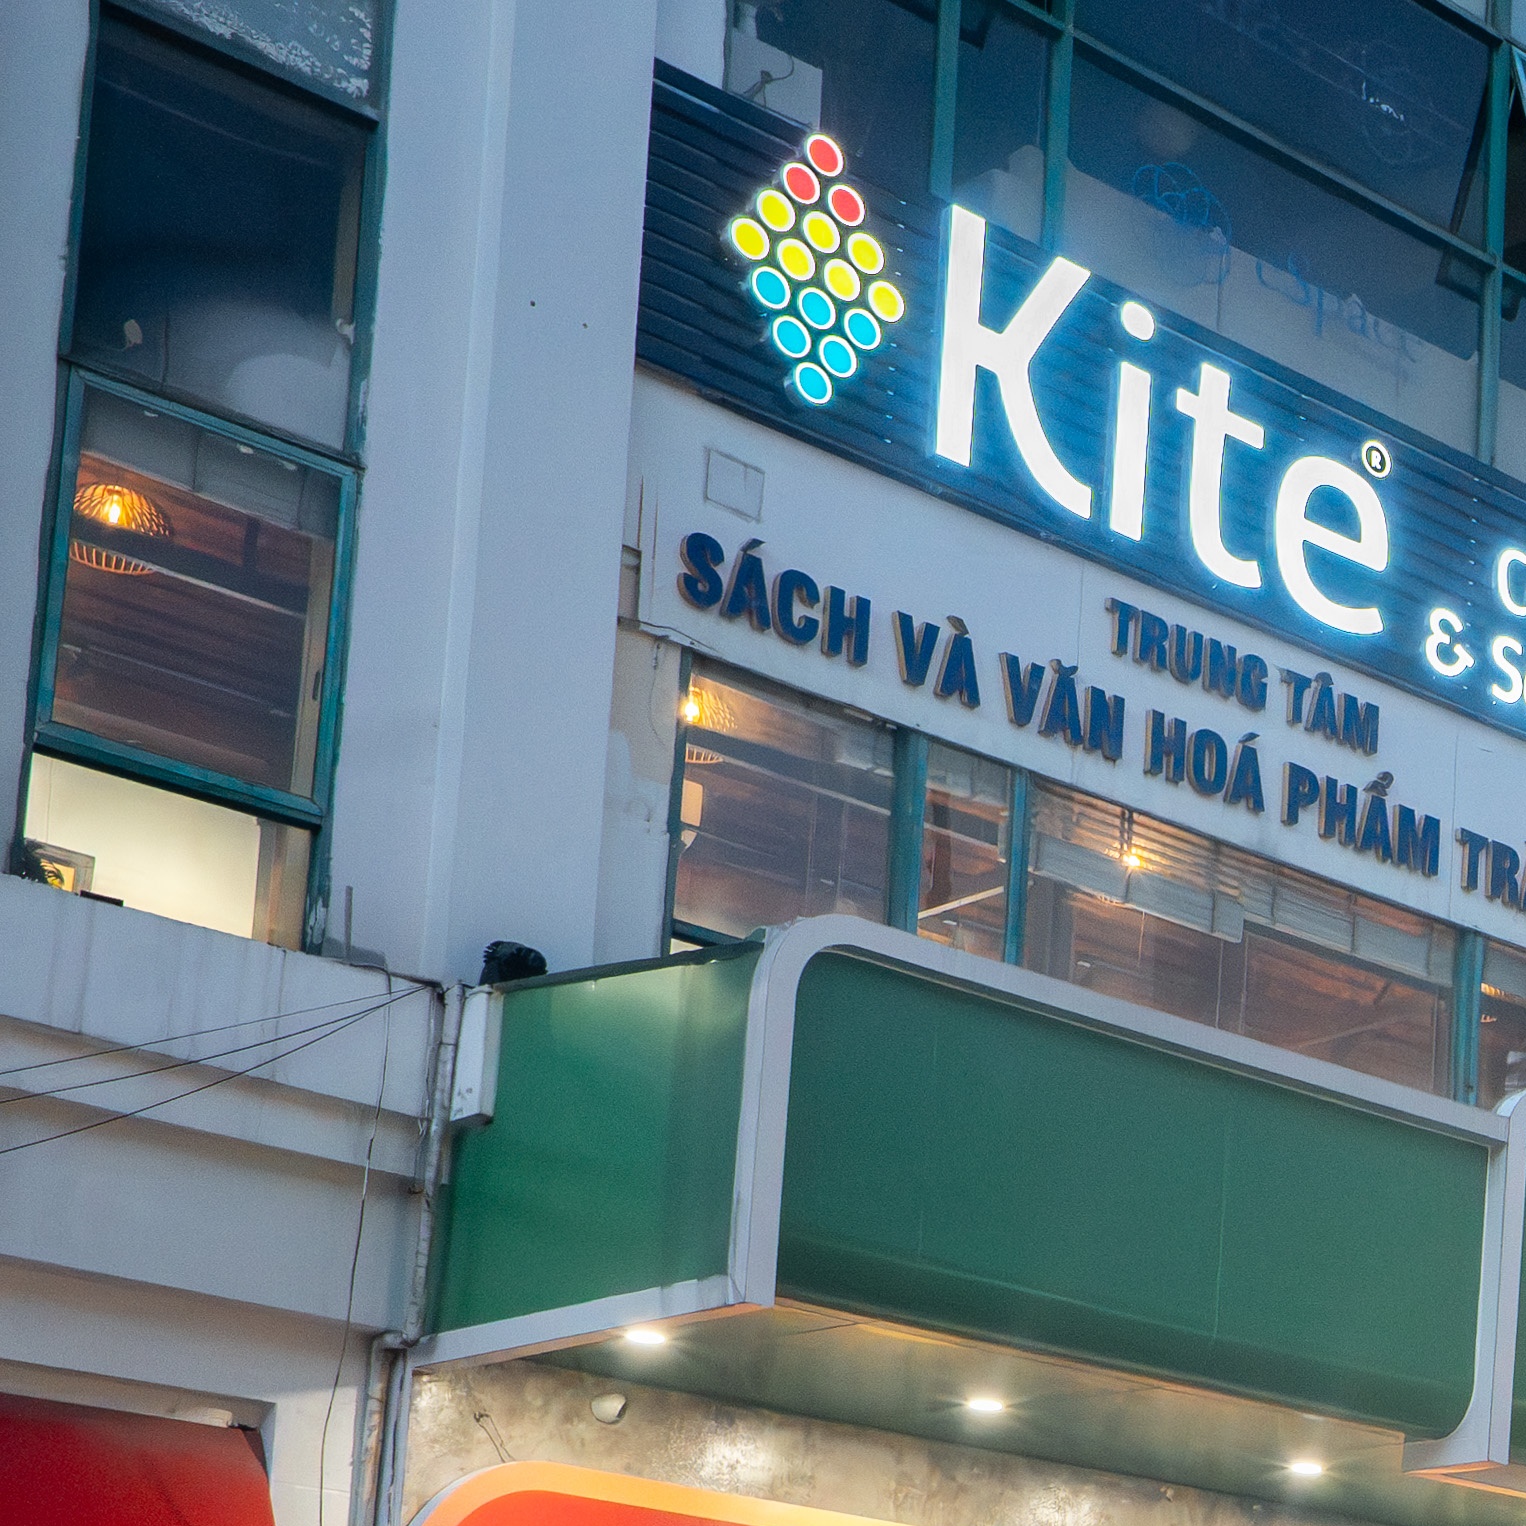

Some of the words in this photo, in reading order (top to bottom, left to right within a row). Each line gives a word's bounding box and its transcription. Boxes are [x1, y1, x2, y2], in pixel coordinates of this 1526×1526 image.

[935, 204, 1389, 635] Kite
[676, 532, 871, 667] SÁCH
[892, 610, 981, 709] VÀ
[999, 652, 1125, 762] VĂN
[1144, 709, 1265, 813] HOÁ
[1281, 771, 1441, 877] PHẨM
[1106, 597, 1268, 712] TRUNG
[1280, 671, 1380, 756] TÂM
[1424, 607, 1475, 678] &
